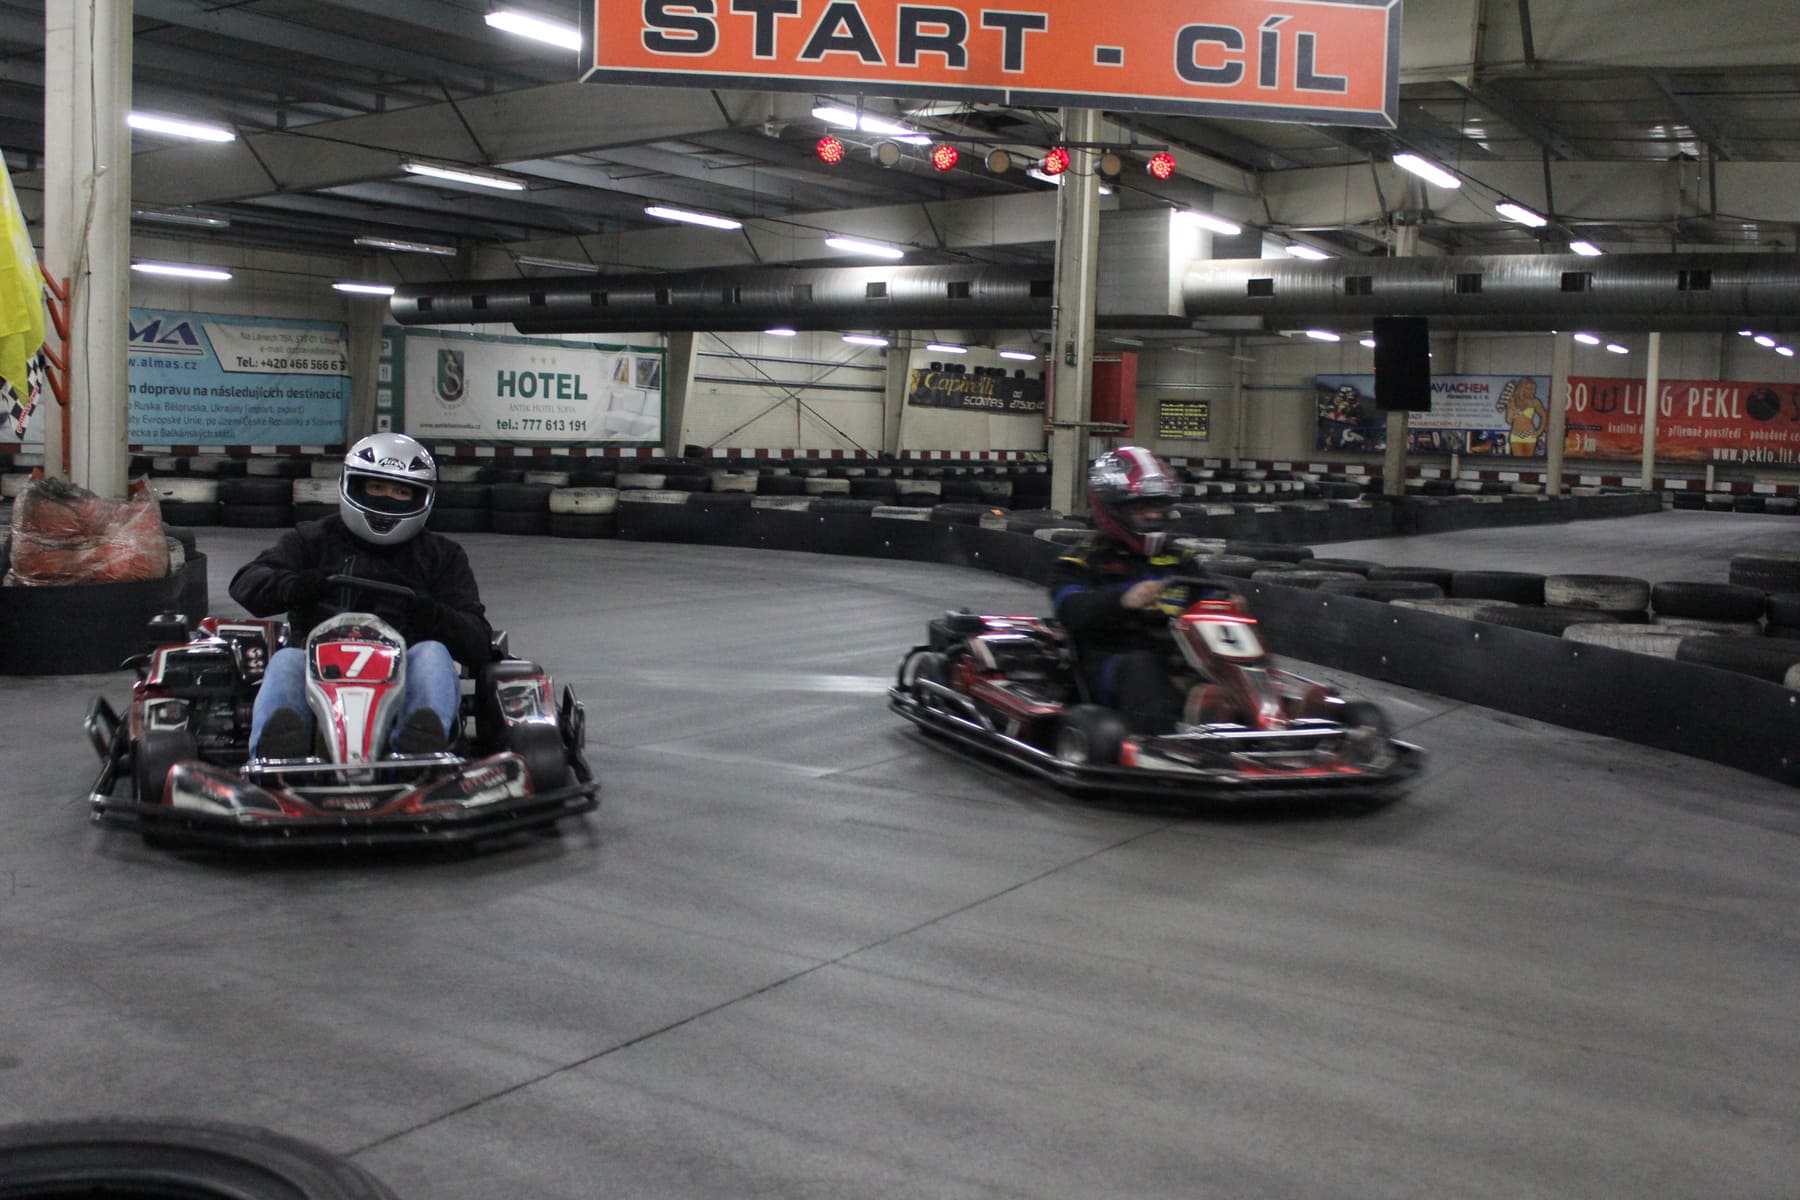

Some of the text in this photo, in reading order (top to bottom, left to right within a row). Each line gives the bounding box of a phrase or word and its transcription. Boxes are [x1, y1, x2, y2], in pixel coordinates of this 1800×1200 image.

[640, 0, 1047, 74] START
[1174, 14, 1348, 94] CÍL
[261, 358, 287, 369] +420
[289, 359, 308, 370] 466
[311, 360, 329, 370] 566
[139, 382, 191, 398] dopravu
[193, 386, 208, 396] na
[497, 369, 588, 401] HOTEL
[496, 418, 587, 432] tel.: 777 613 191
[340, 645, 376, 678] 7
